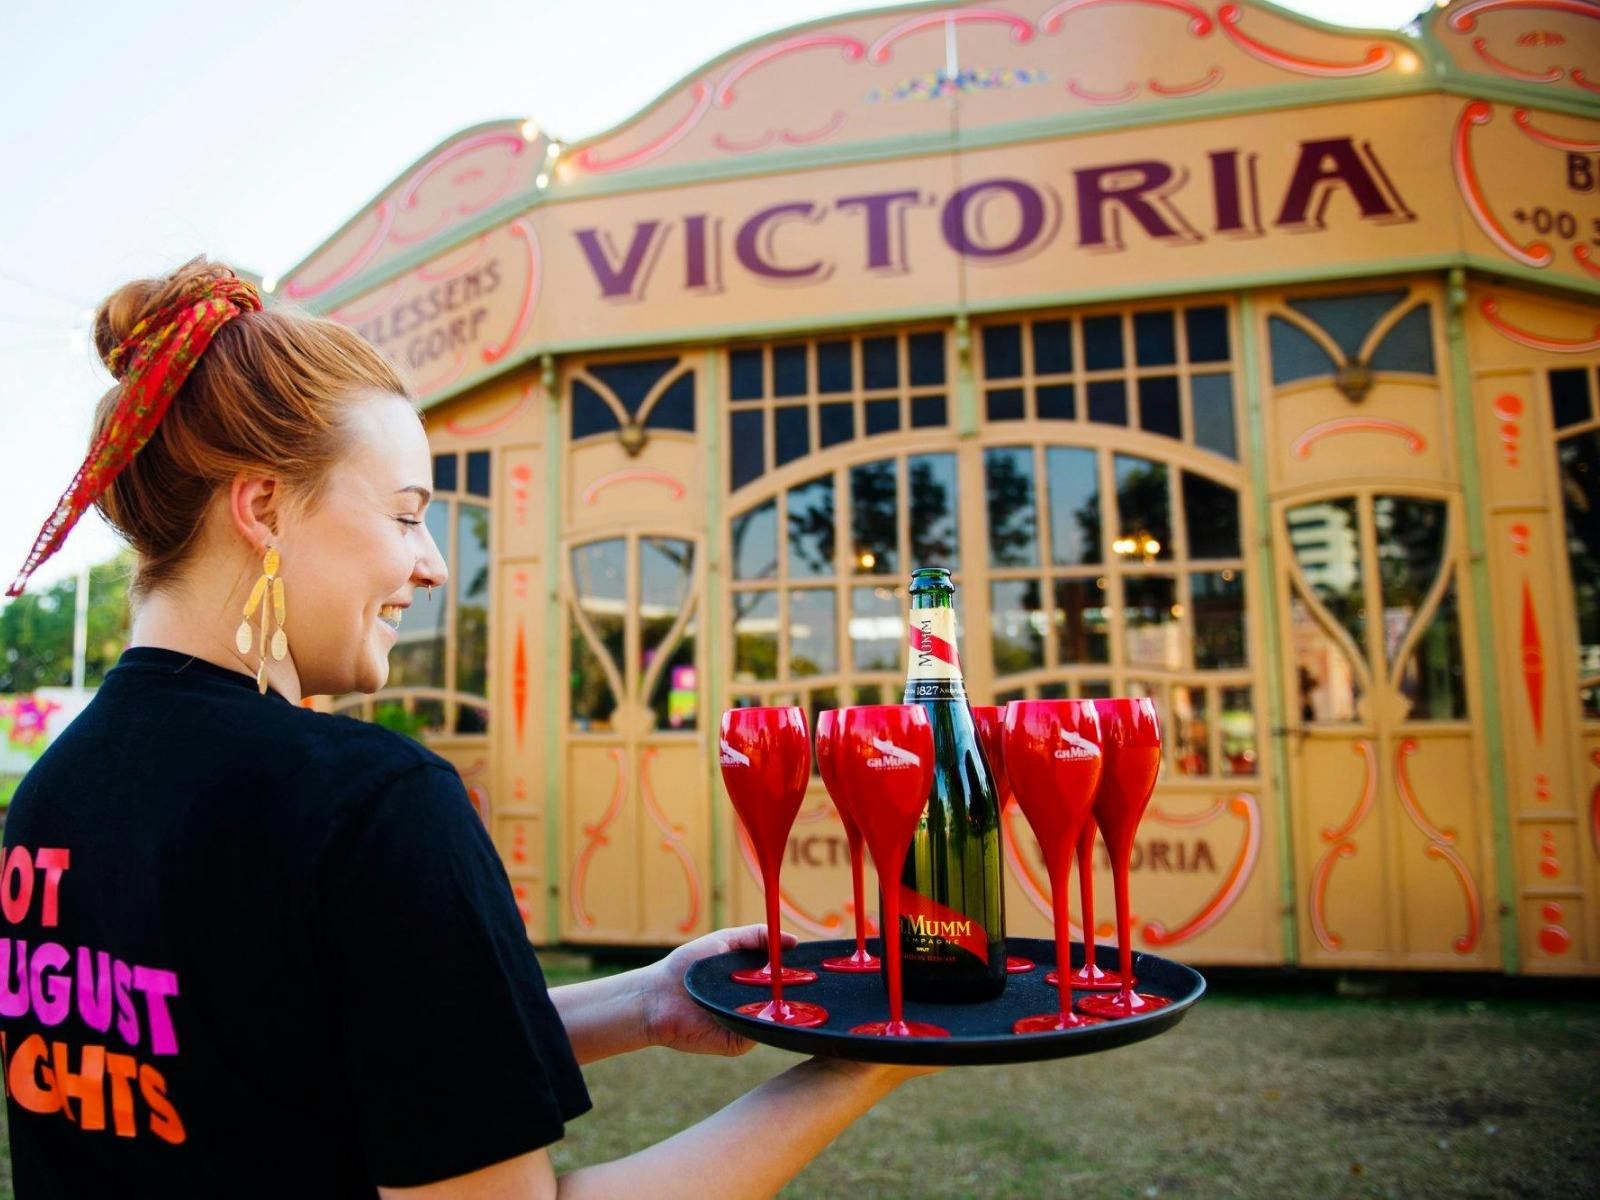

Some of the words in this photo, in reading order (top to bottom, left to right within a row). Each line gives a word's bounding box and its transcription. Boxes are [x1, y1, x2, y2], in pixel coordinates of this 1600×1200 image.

[573, 134, 1417, 304] VICTORIA
[918, 619, 932, 667] MUMM
[916, 683, 940, 696] 1827
[0, 845, 70, 927] OT
[905, 937, 960, 945] MPAGNE
[0, 938, 180, 1055] UGUST
[0, 1031, 187, 1145] GHTS
